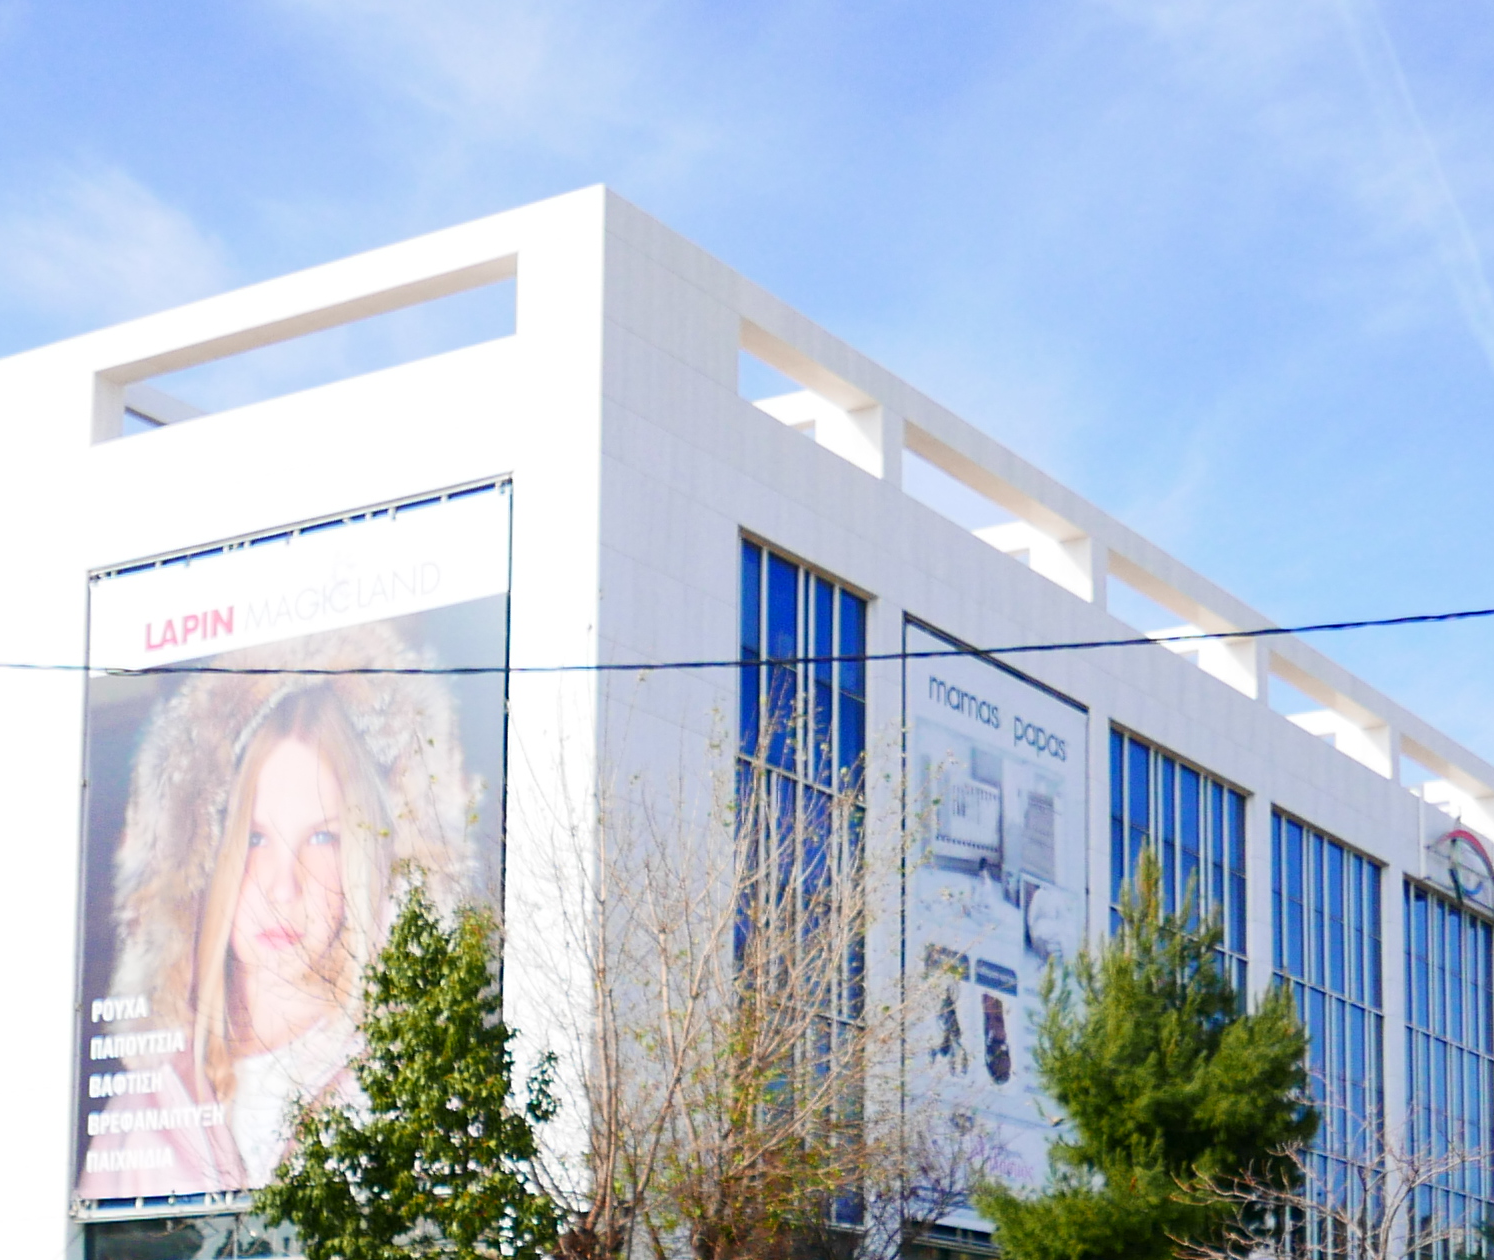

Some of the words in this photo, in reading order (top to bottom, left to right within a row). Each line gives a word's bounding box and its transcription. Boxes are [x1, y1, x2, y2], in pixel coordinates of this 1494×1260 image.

[144, 605, 235, 652] LAPIN
[929, 674, 1000, 730] mamas
[1013, 715, 1067, 762] papas
[91, 994, 150, 1022] ΡΟΥΧΑ
[90, 1029, 186, 1060] ΠΑΠΟΥΤΣΙΑ
[89, 1069, 163, 1098] ΒΑΦΤΙΣΗ
